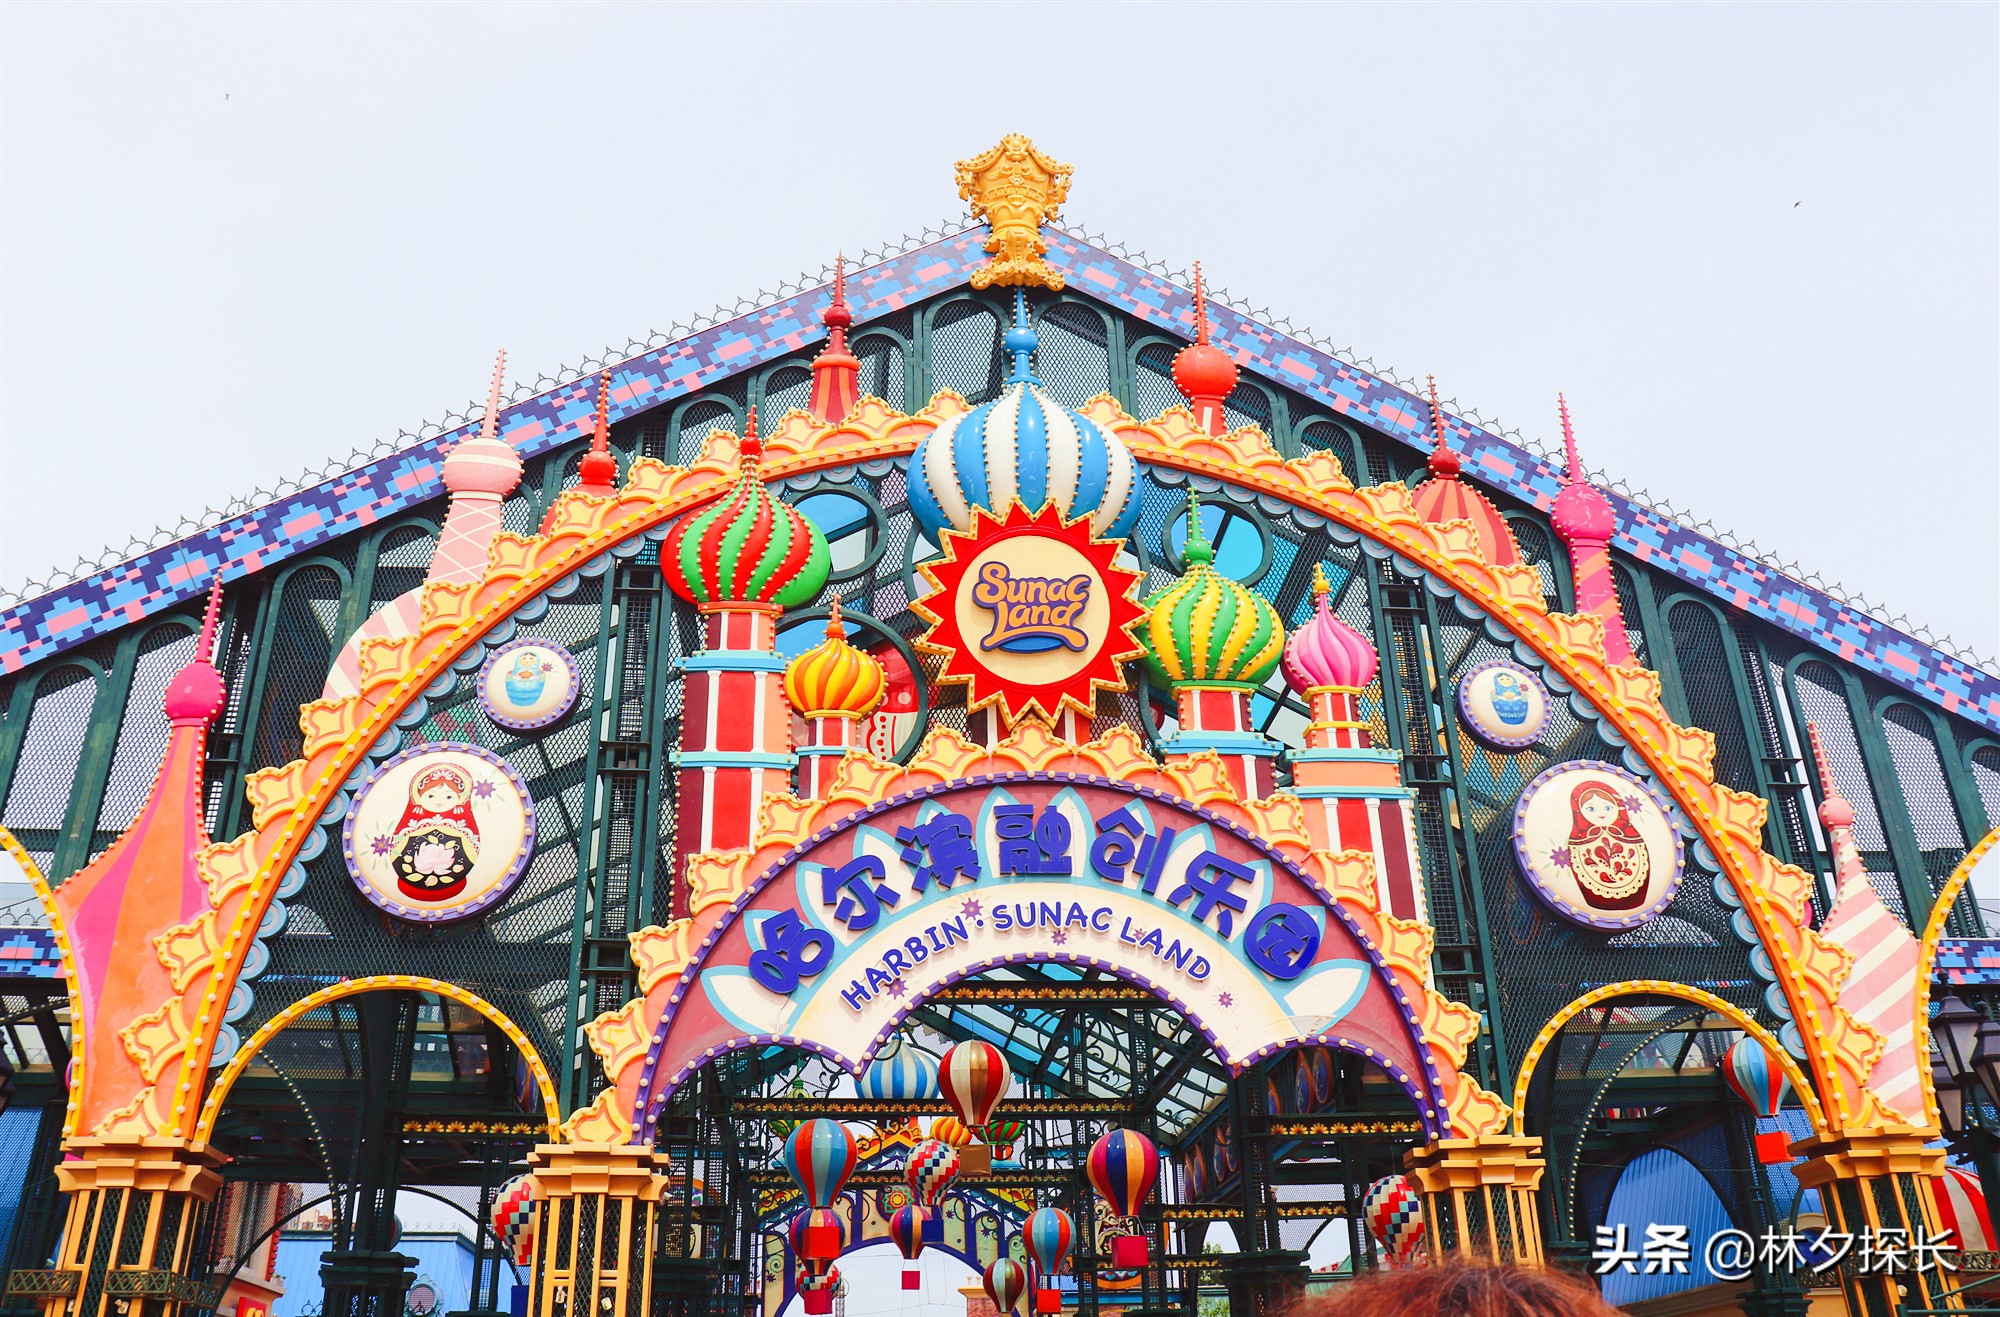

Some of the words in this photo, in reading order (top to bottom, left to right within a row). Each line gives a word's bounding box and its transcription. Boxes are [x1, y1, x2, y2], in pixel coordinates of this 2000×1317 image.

[973, 561, 1092, 606] Sunac
[981, 601, 1089, 651] Land
[749, 804, 1320, 994] 哈尔滨融创乐园
[1119, 915, 1212, 980] LAND
